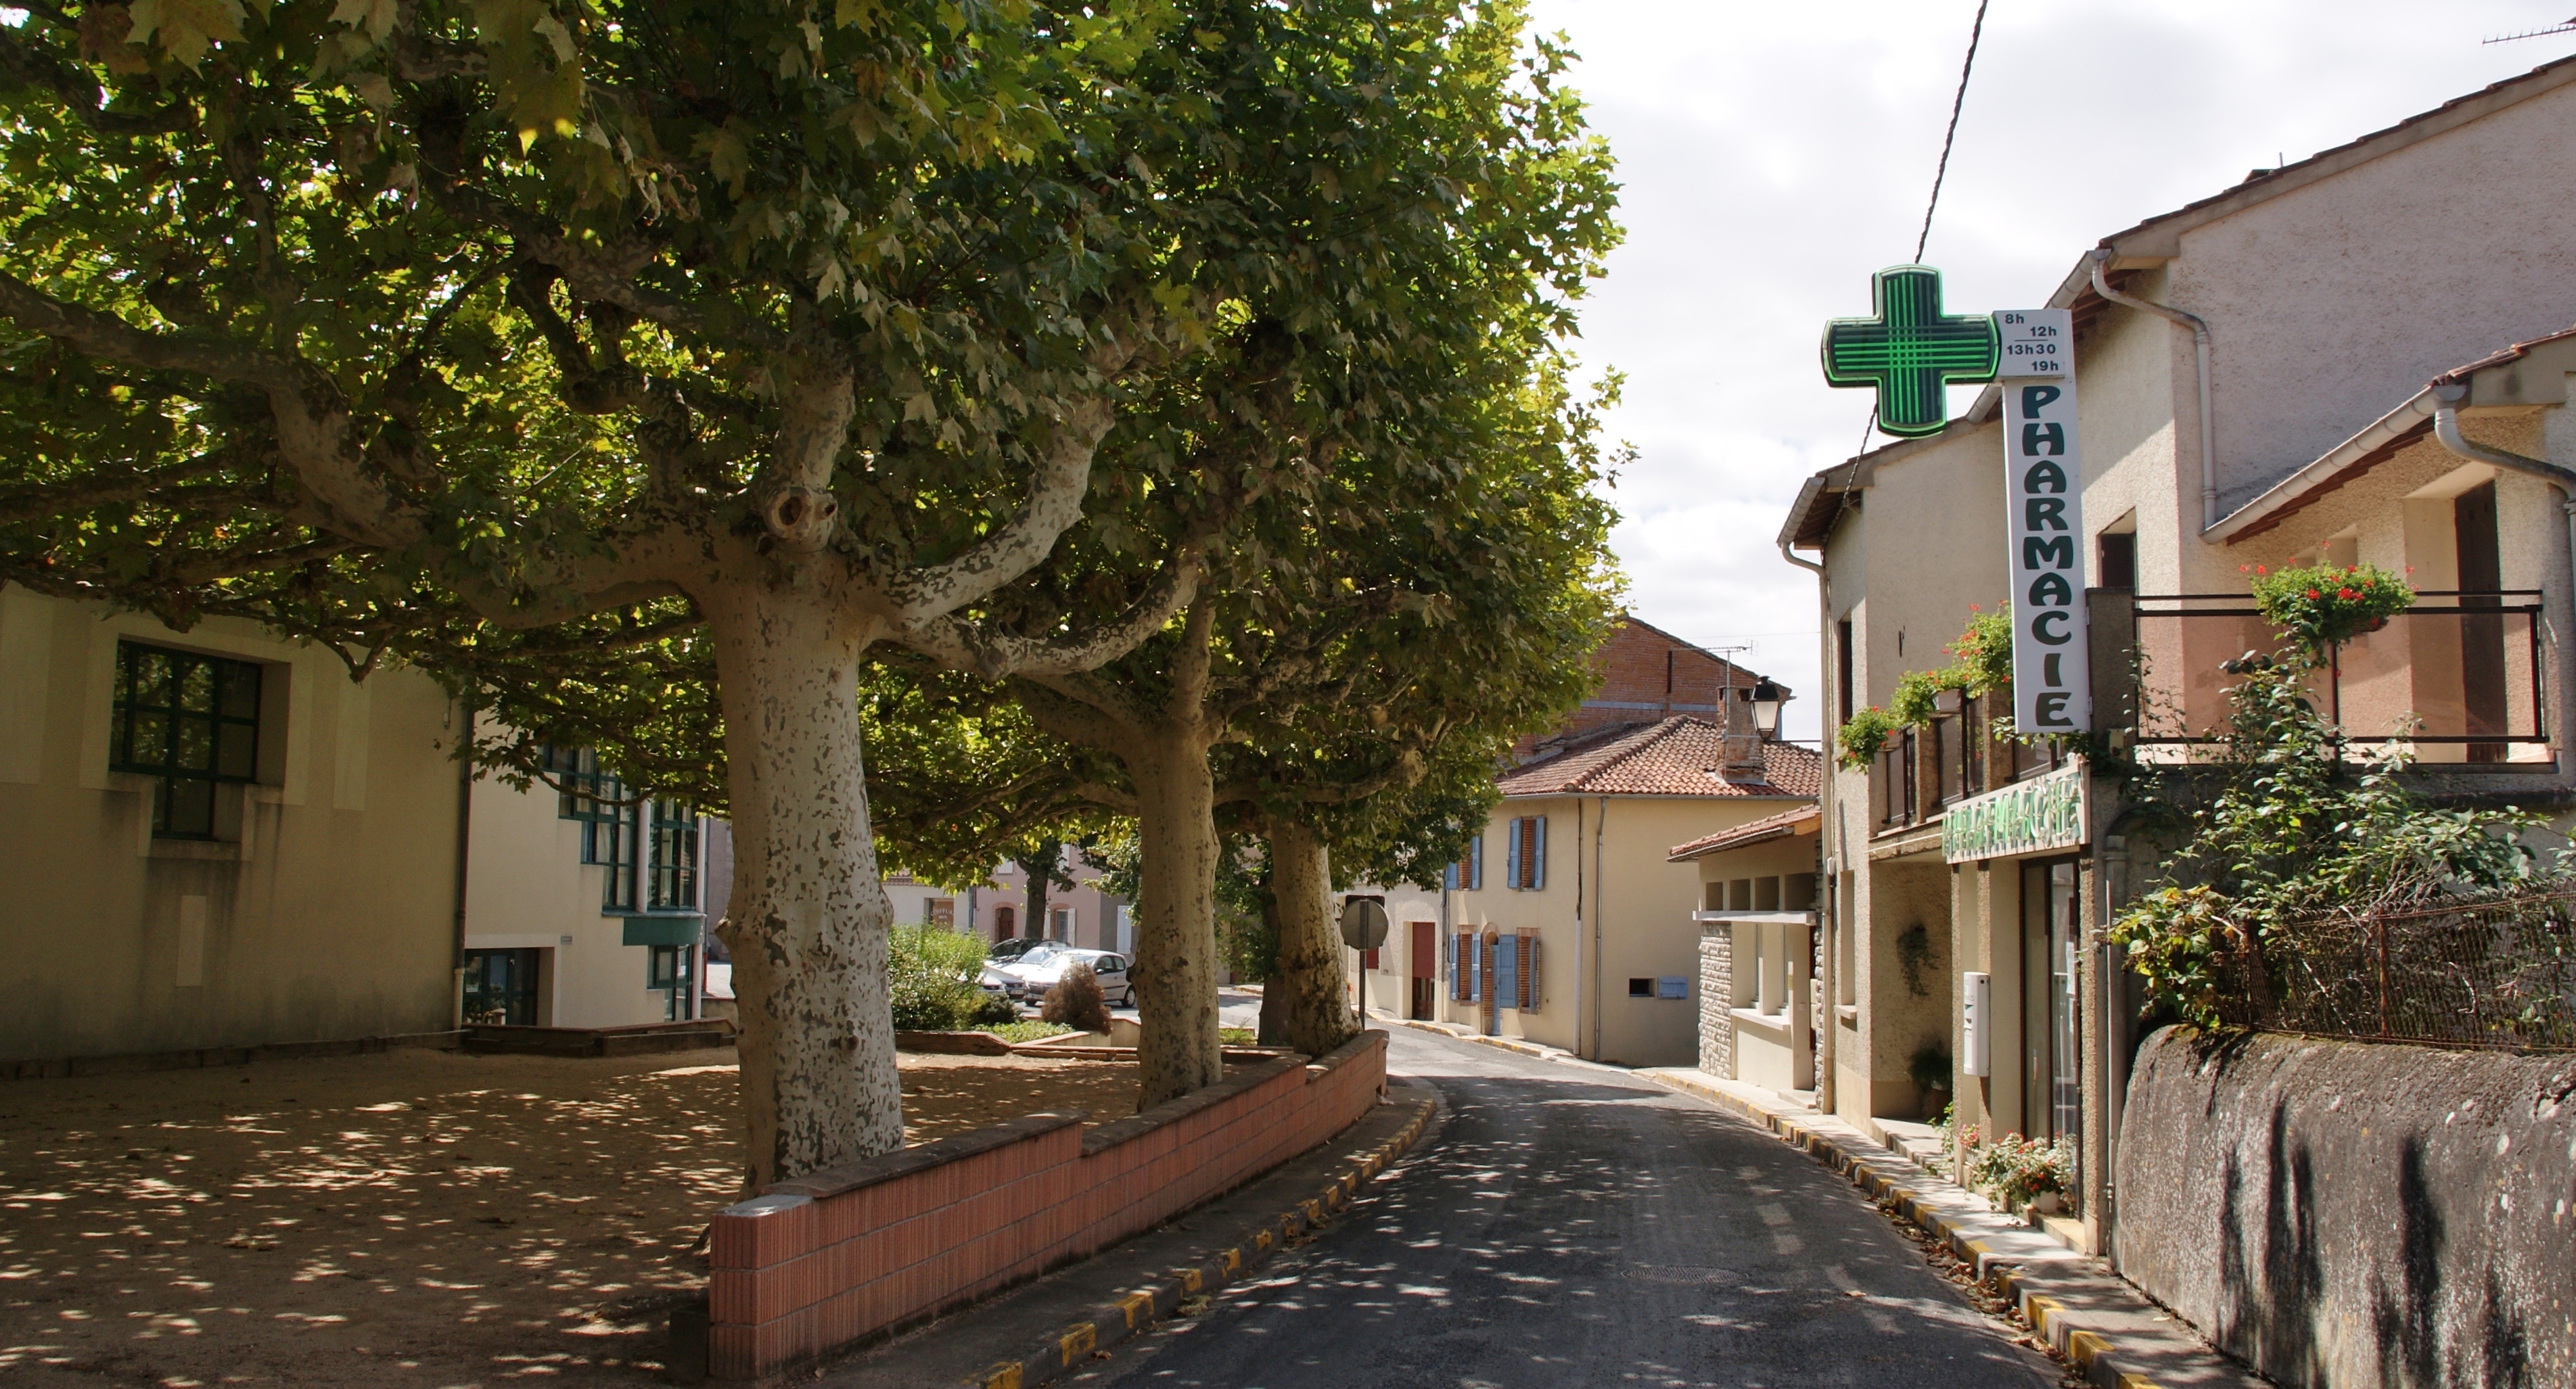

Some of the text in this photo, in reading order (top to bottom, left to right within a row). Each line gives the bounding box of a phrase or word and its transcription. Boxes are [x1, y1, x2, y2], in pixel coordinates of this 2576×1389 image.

[2004, 314, 2024, 324] 8h
[2030, 326, 2057, 337] 12h
[2006, 344, 2056, 355] 13h30
[2031, 361, 2058, 371] 19h
[2022, 385, 2073, 727] PHARMACIE
